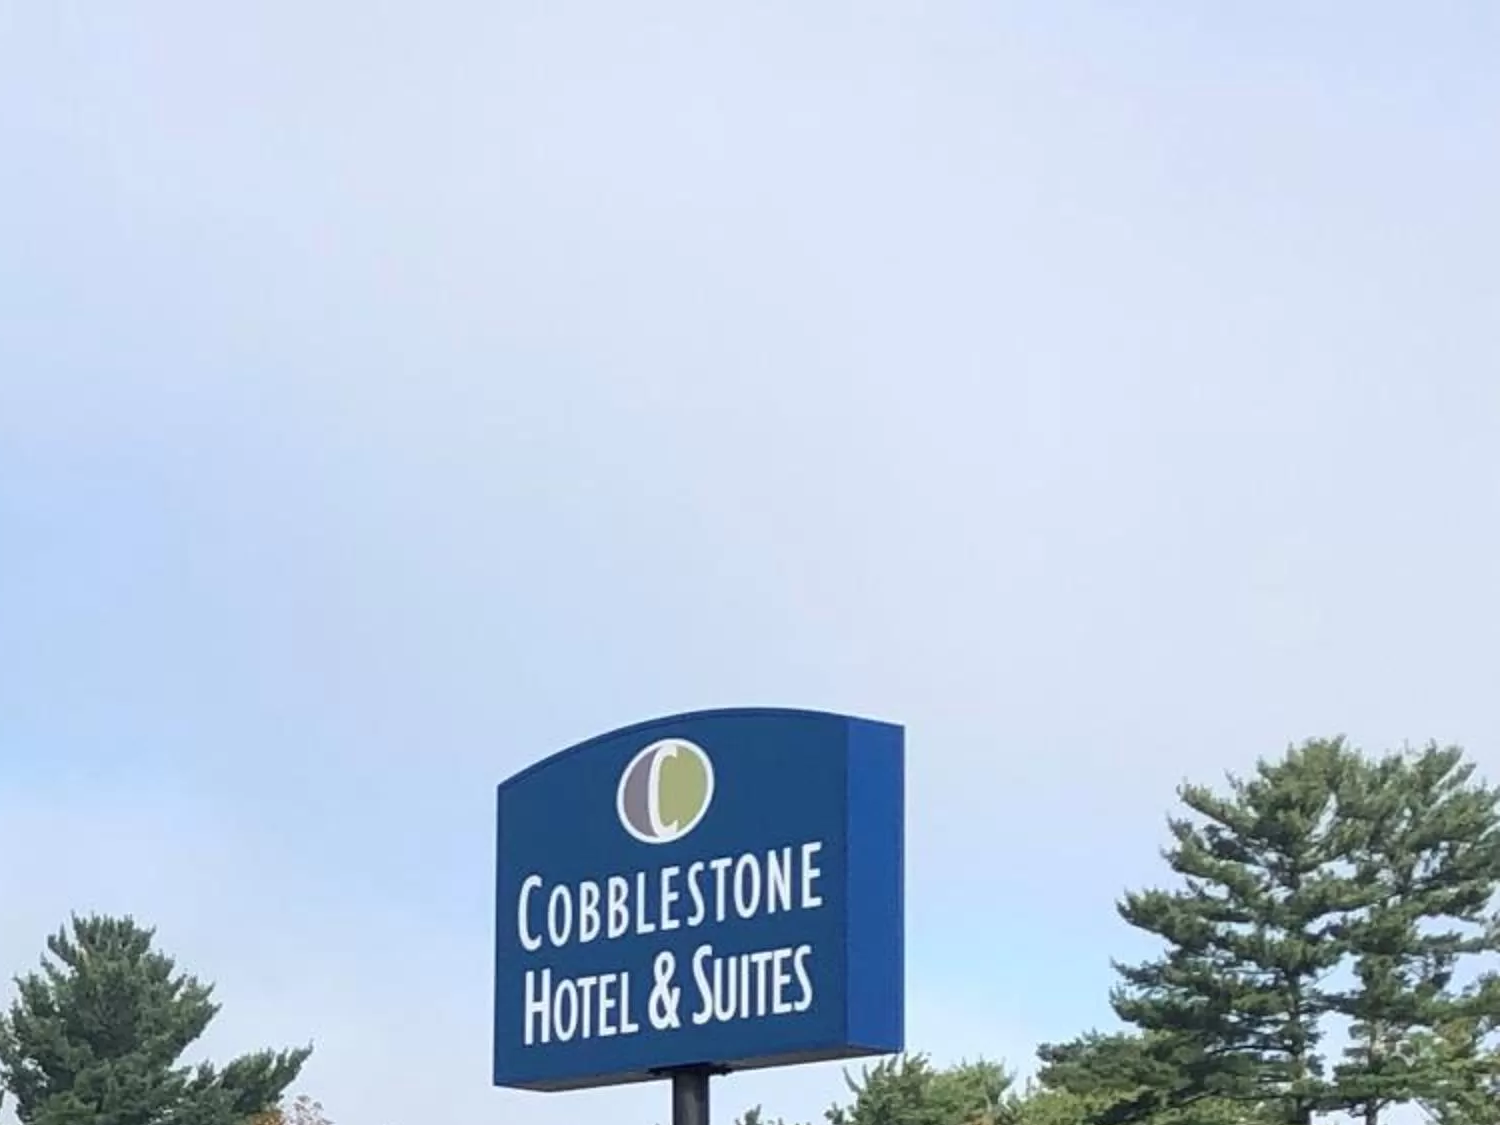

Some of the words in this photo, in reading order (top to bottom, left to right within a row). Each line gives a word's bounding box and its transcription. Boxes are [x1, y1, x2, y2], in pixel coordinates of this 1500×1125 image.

[518, 841, 822, 951] COBBLESTONE
[524, 968, 639, 1045] HOTEL
[648, 951, 681, 1030] &
[692, 944, 813, 1025] SUITES
